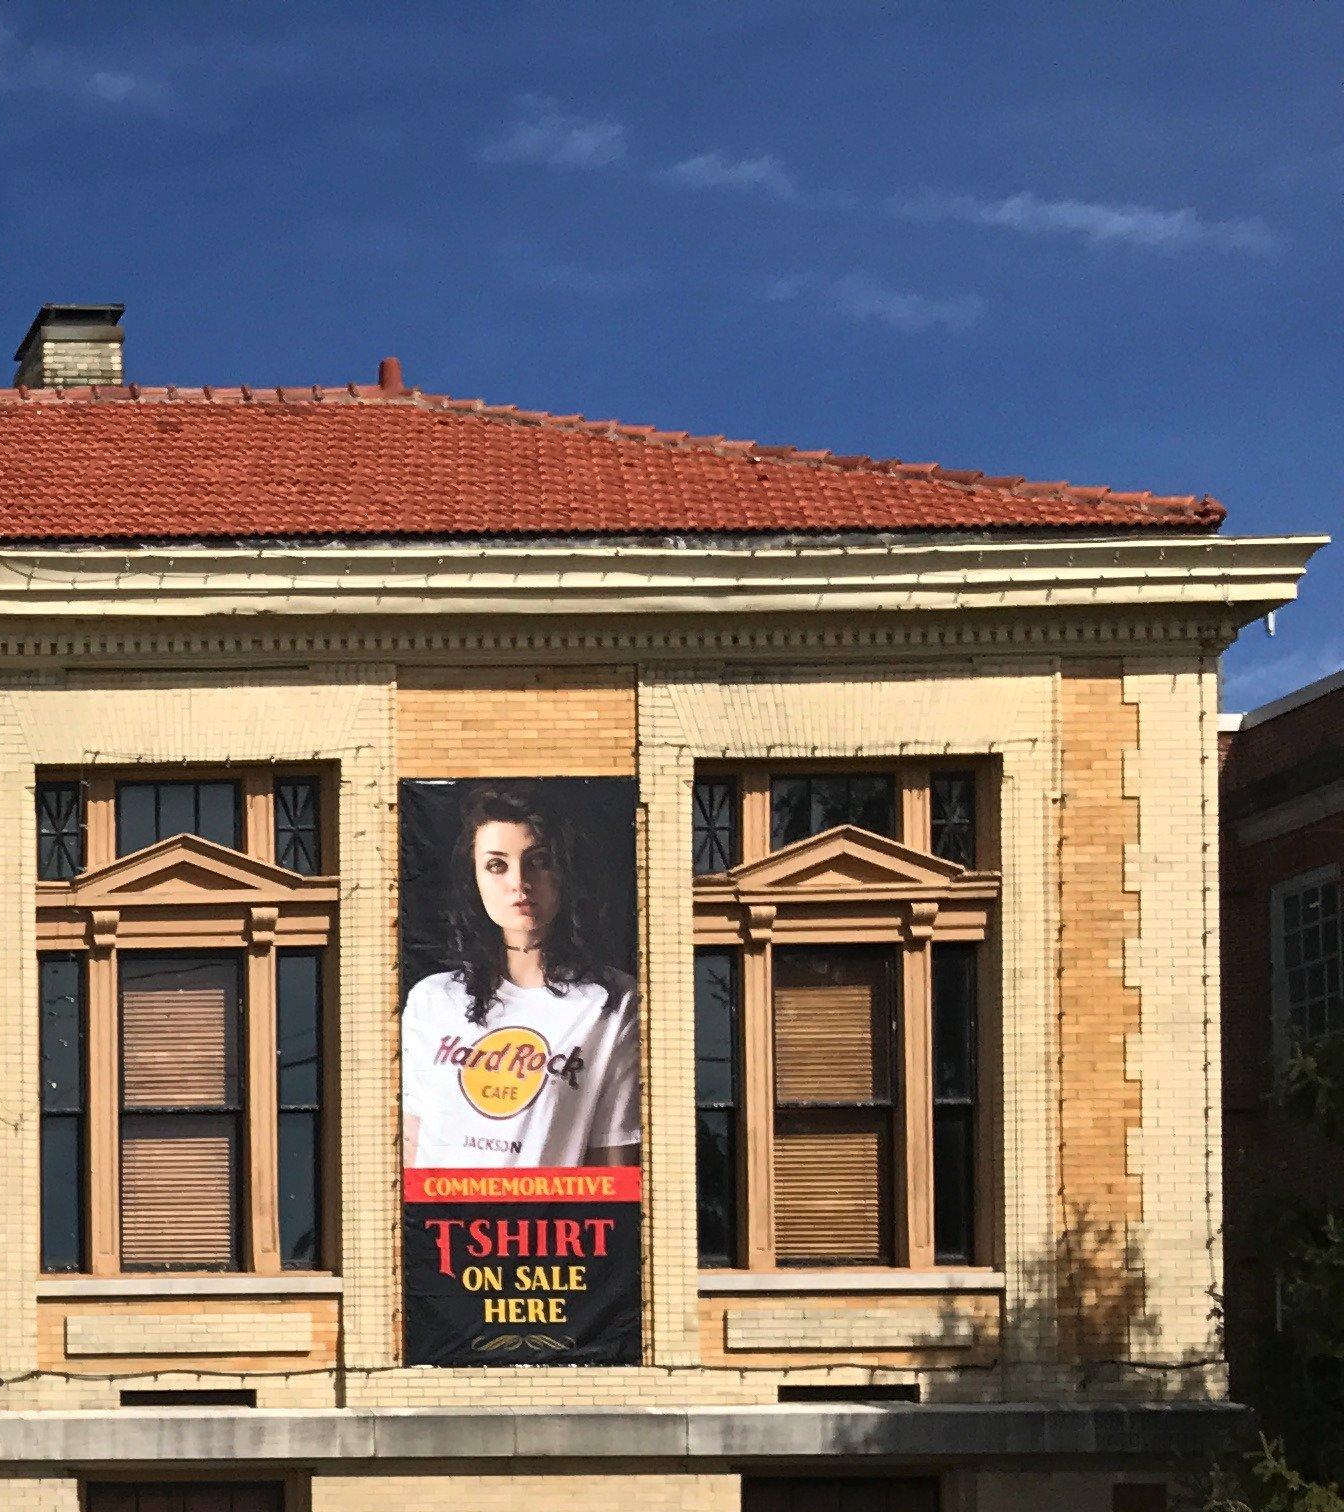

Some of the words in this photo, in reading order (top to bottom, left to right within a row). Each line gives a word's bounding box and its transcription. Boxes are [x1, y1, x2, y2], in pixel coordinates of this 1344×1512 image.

[433, 1035, 511, 1071] Hard
[507, 1043, 584, 1090] Rock
[481, 1085, 518, 1100] CAFE
[463, 1136, 522, 1154] JACKSON
[423, 1175, 616, 1198] COMMEMORATIVE
[462, 1266, 504, 1292] ON
[514, 1264, 587, 1292] SALE
[483, 1298, 567, 1324] HERE
